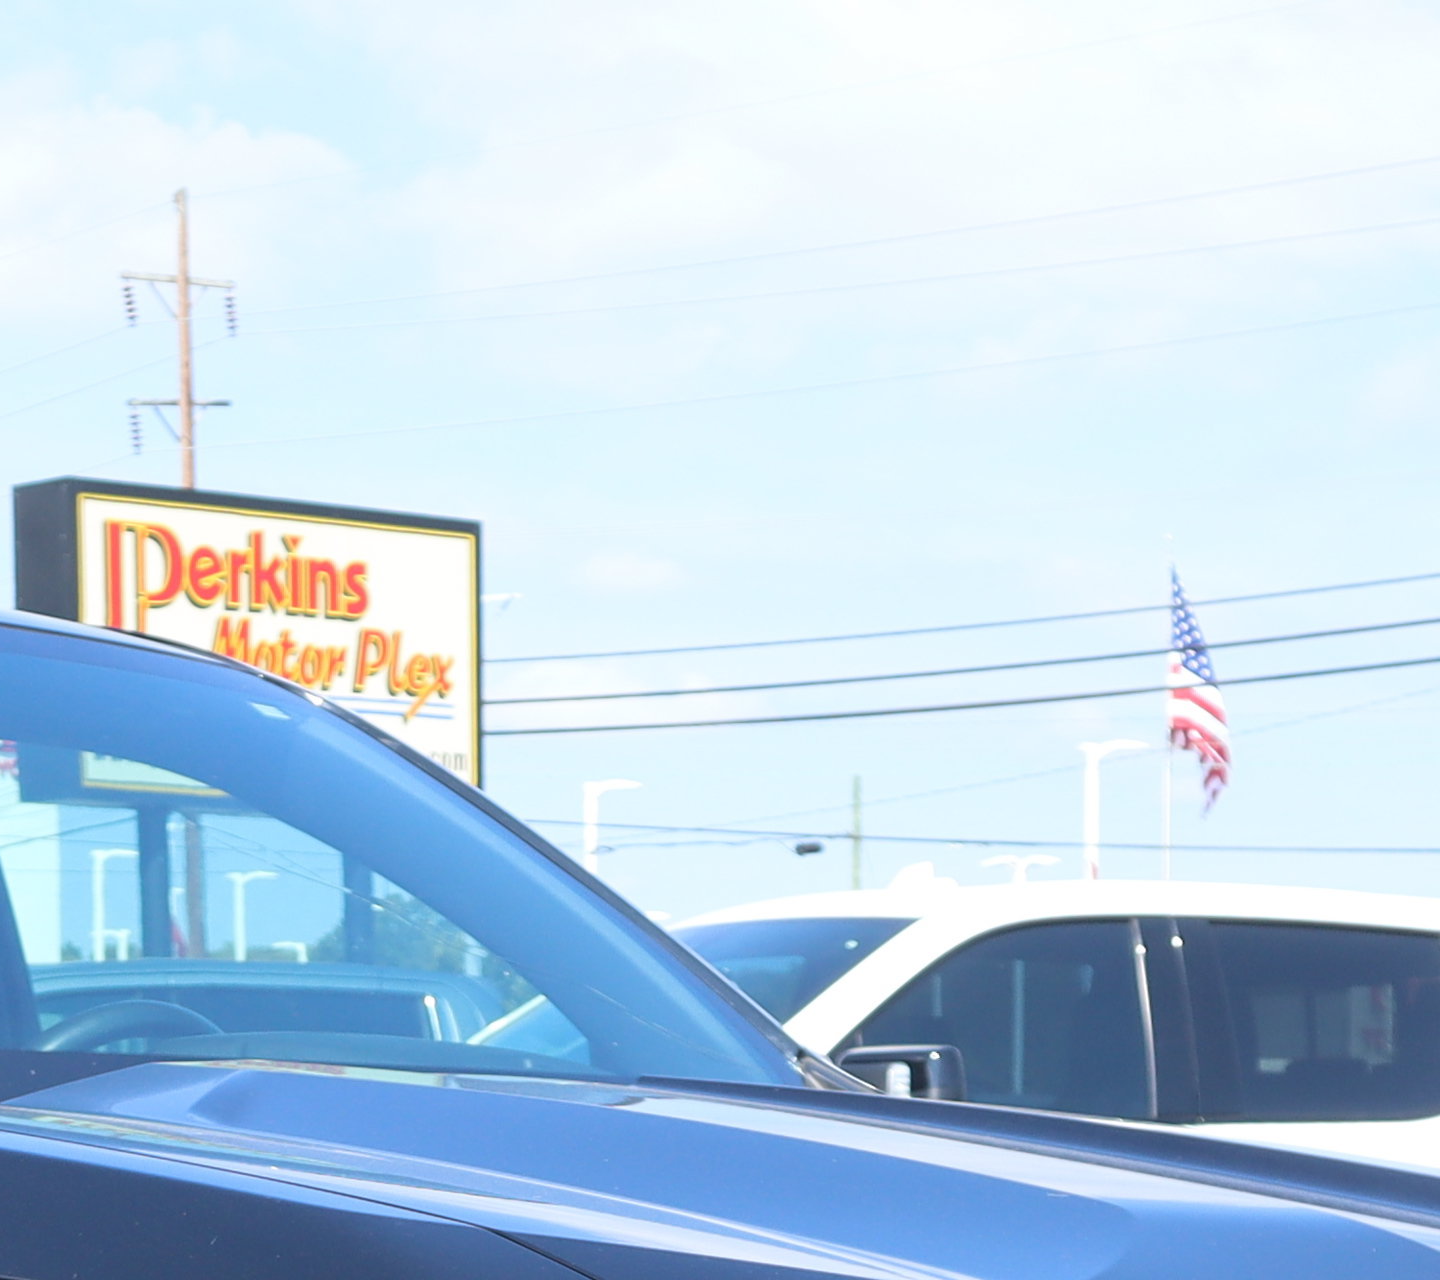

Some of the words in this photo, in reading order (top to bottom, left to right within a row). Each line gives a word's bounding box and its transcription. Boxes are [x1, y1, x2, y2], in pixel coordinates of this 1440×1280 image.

[104, 518, 370, 633] Perkins
[213, 615, 347, 691] Motor
[351, 628, 454, 722] Plex
